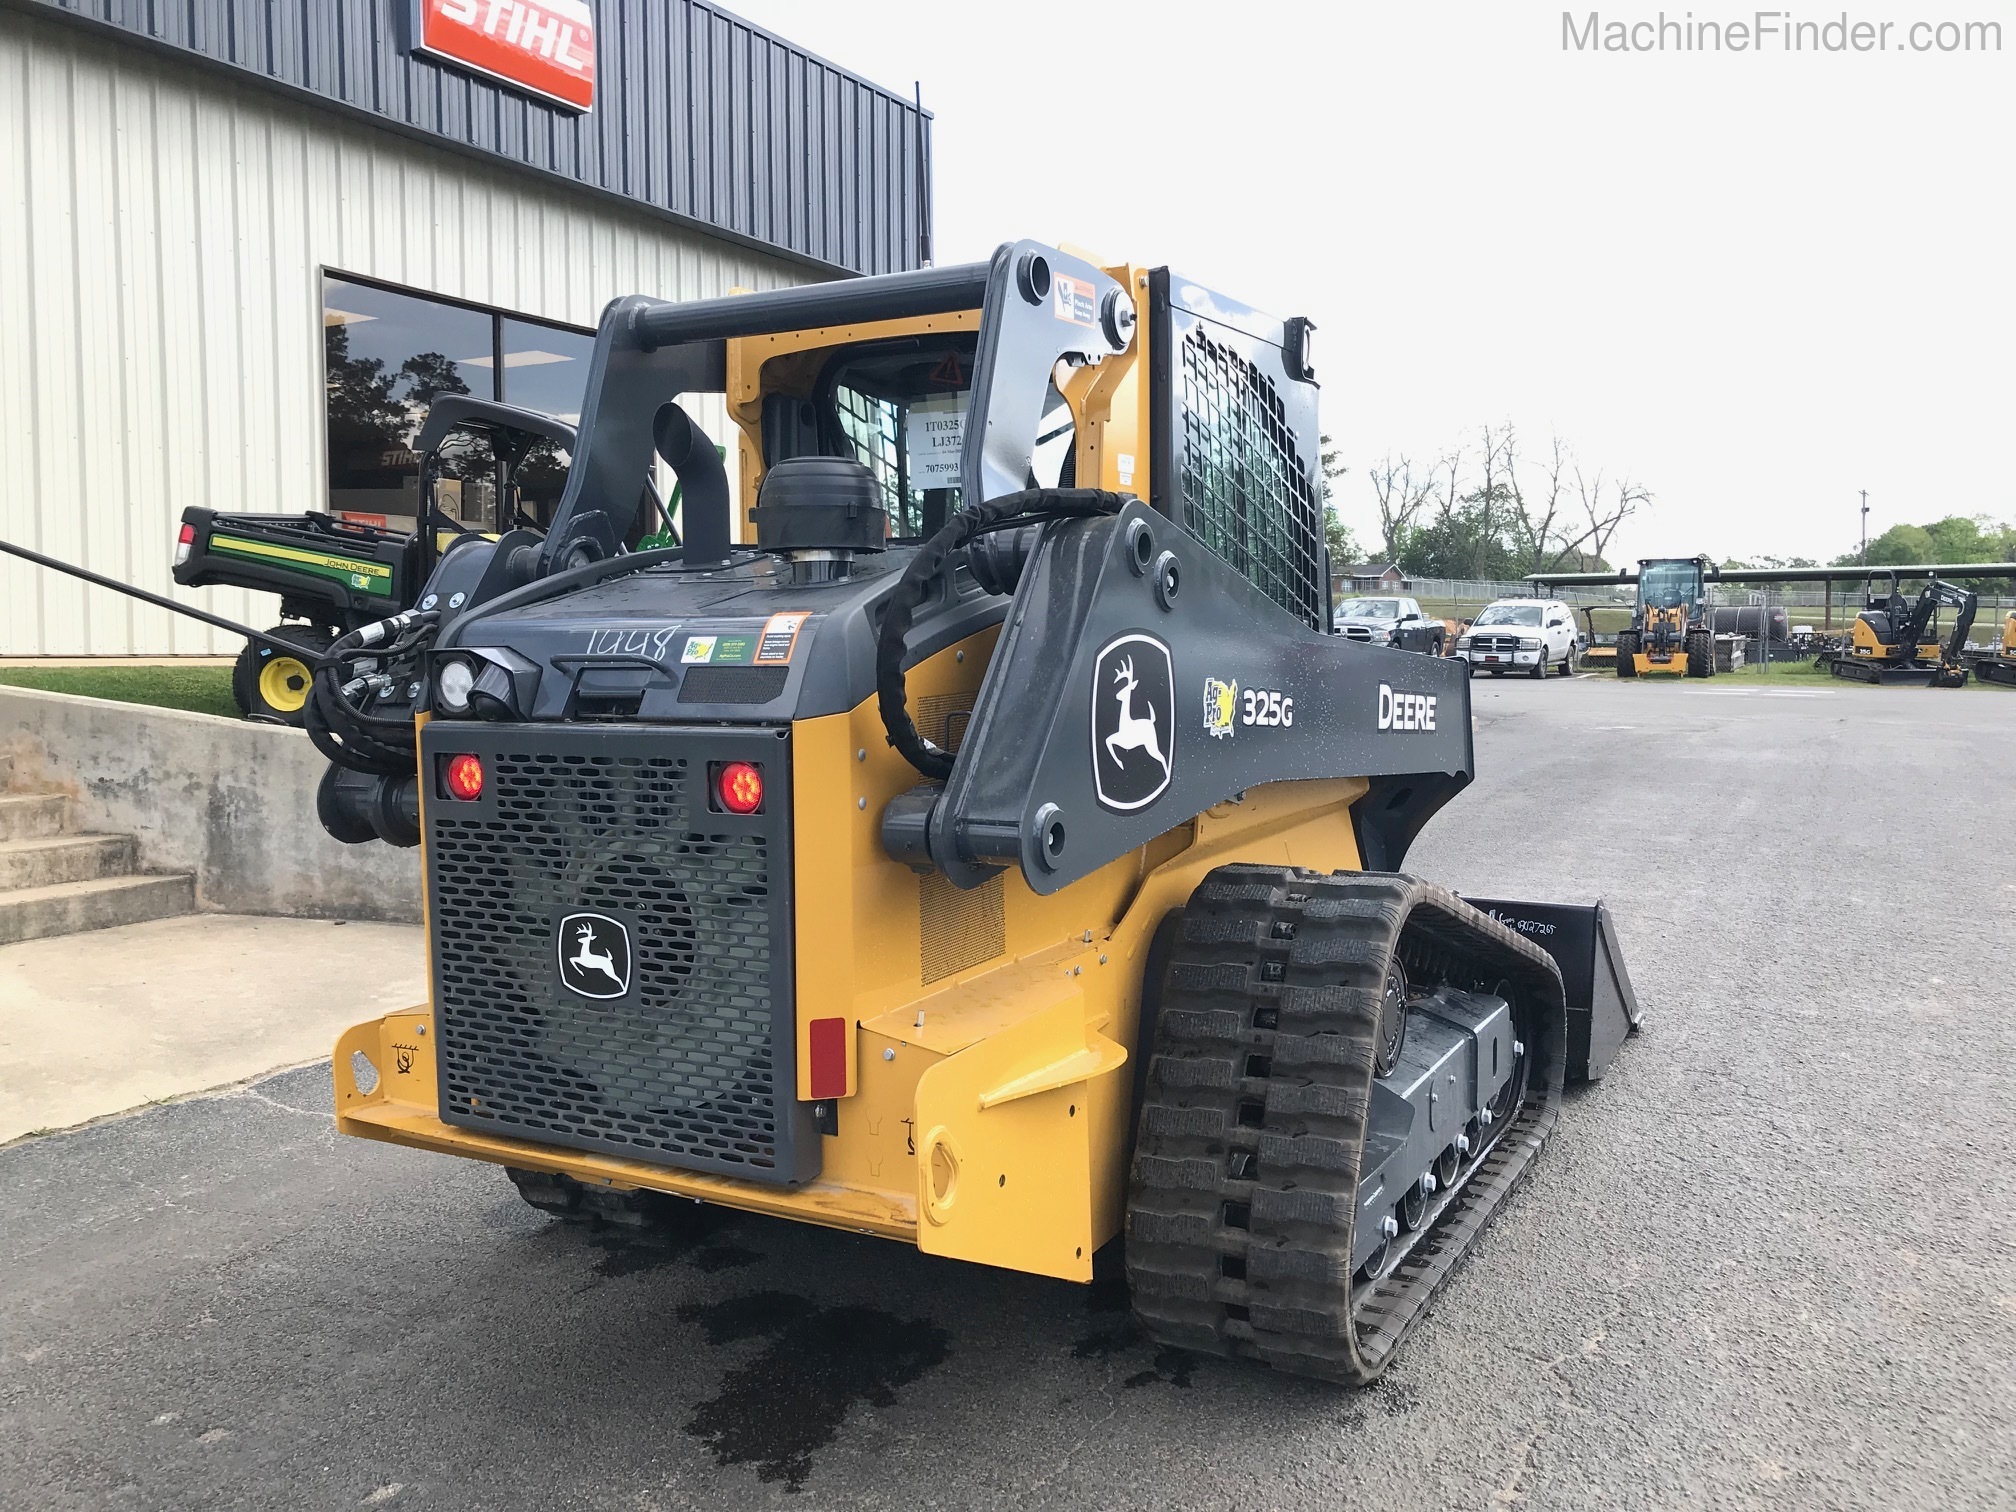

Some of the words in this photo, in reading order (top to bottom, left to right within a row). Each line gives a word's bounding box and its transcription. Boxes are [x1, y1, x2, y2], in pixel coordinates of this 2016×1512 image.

[925, 462, 959, 473] 7075993
[324, 559, 349, 571] JOHN
[350, 563, 380, 576] DEERE
[1206, 702, 1222, 723] Pro
[1242, 689, 1294, 728] 325G
[1378, 683, 1437, 731] DEERE
